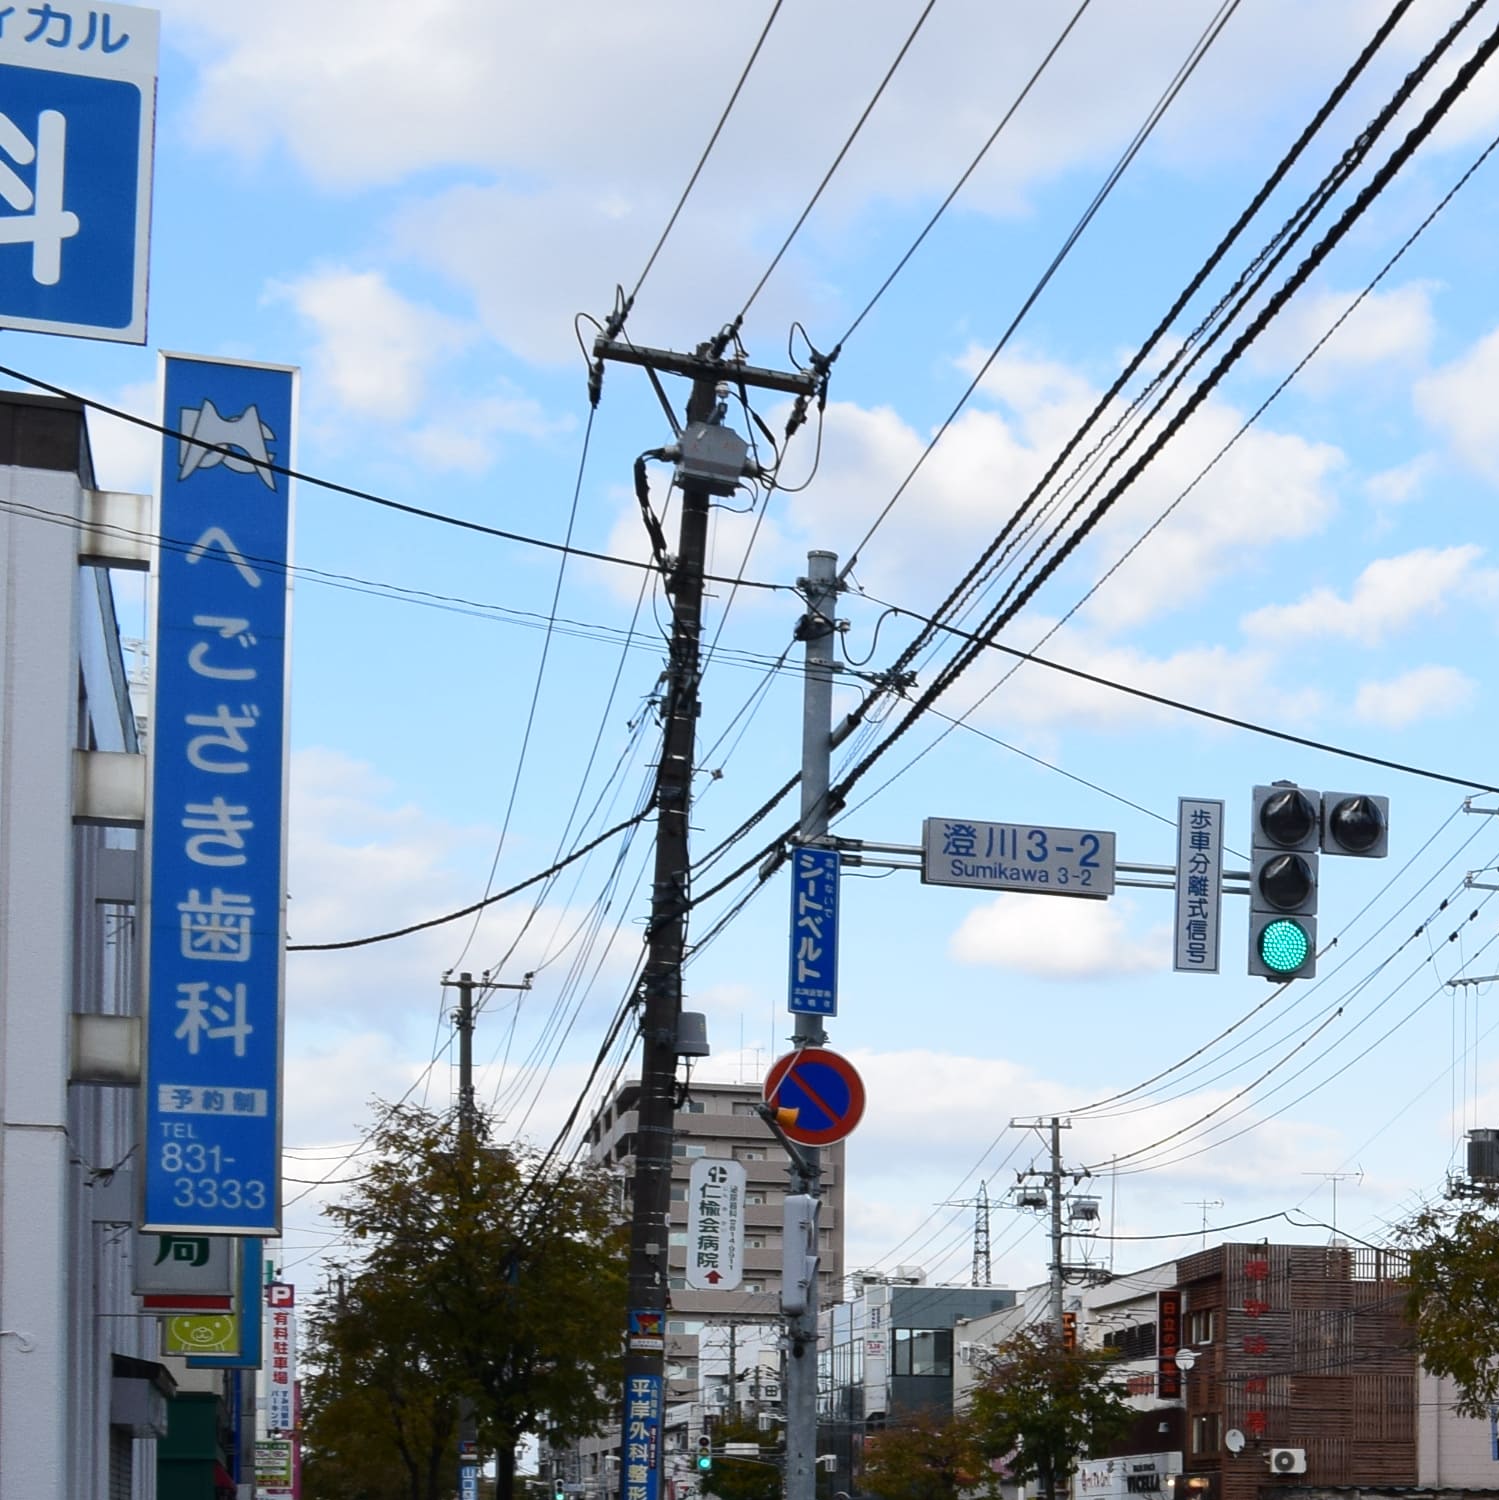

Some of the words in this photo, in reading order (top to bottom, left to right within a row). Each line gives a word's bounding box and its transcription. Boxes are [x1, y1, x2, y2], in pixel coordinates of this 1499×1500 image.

[175, 526, 268, 1058] へござき歯科
[941, 823, 1101, 869] 澄川3-2
[949, 858, 1050, 887] Sumikawa
[1056, 868, 1094, 888] 3-2
[1186, 809, 1212, 967] 歩車分離式信号
[797, 854, 825, 984] シートベルト
[171, 1088, 256, 1113] 予約制
[160, 1122, 197, 1138] TEL
[161, 1142, 236, 1174] 831-
[173, 1177, 266, 1210] 3333
